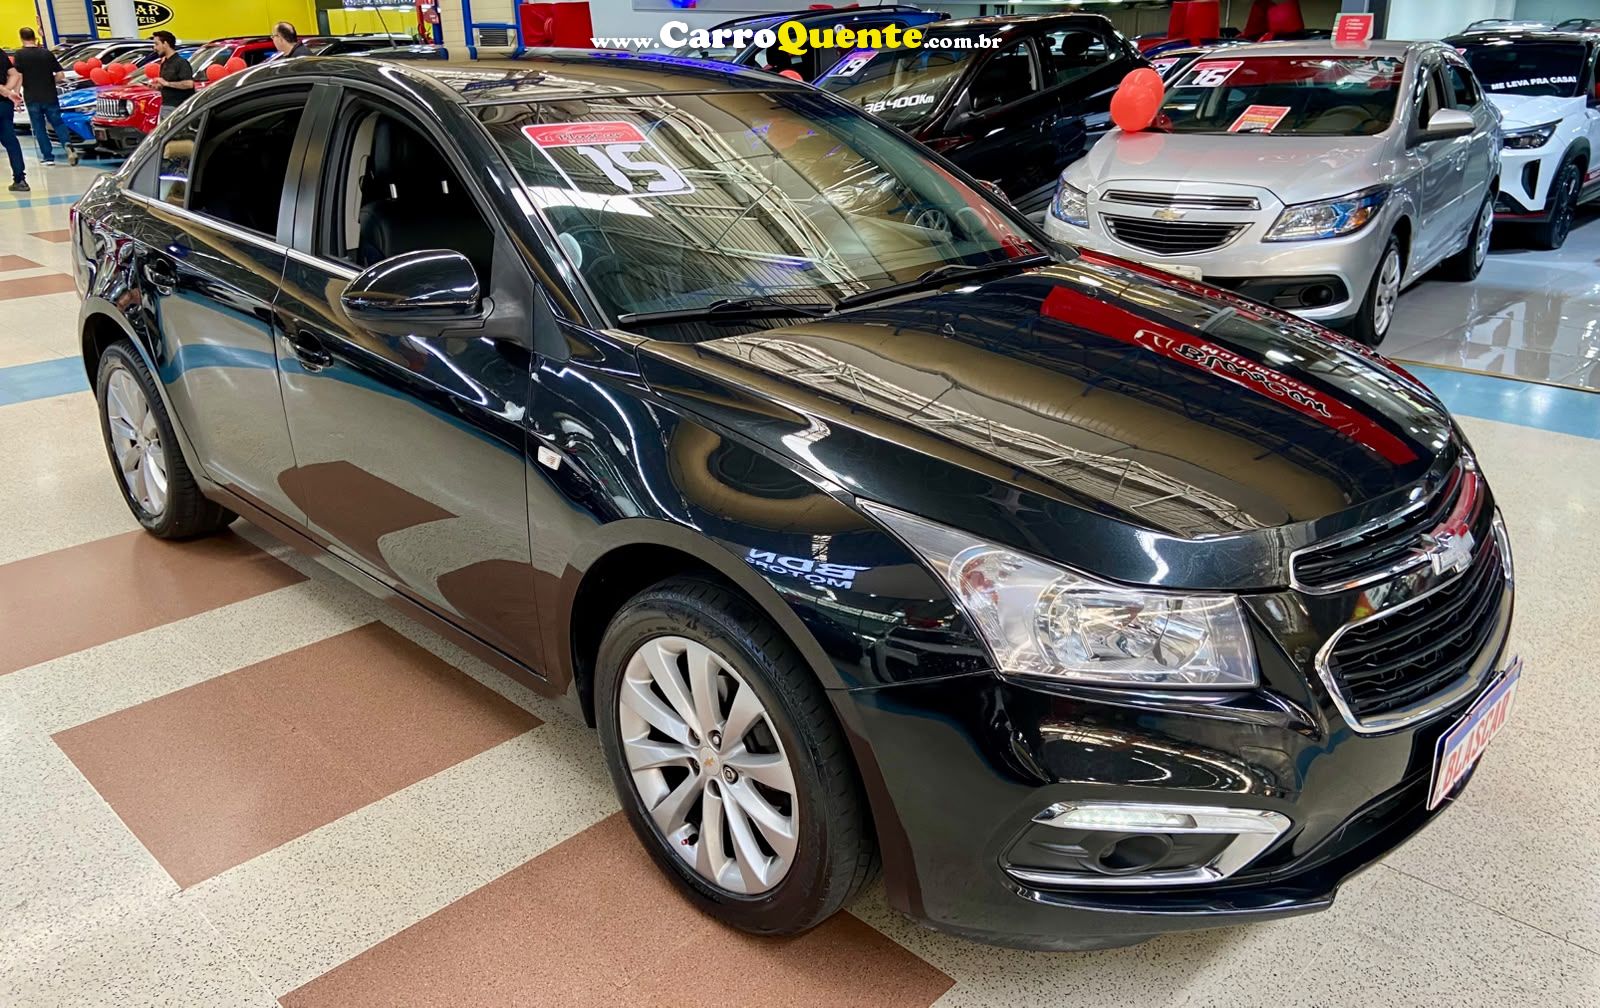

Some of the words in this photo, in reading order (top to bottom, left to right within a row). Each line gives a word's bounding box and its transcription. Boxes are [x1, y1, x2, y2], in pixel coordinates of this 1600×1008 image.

[1192, 69, 1226, 86] 16
[1491, 82, 1505, 90] ME
[1506, 79, 1530, 88] LEVA
[1531, 77, 1549, 86] PRA
[1443, 689, 1512, 793] BLASCAR
